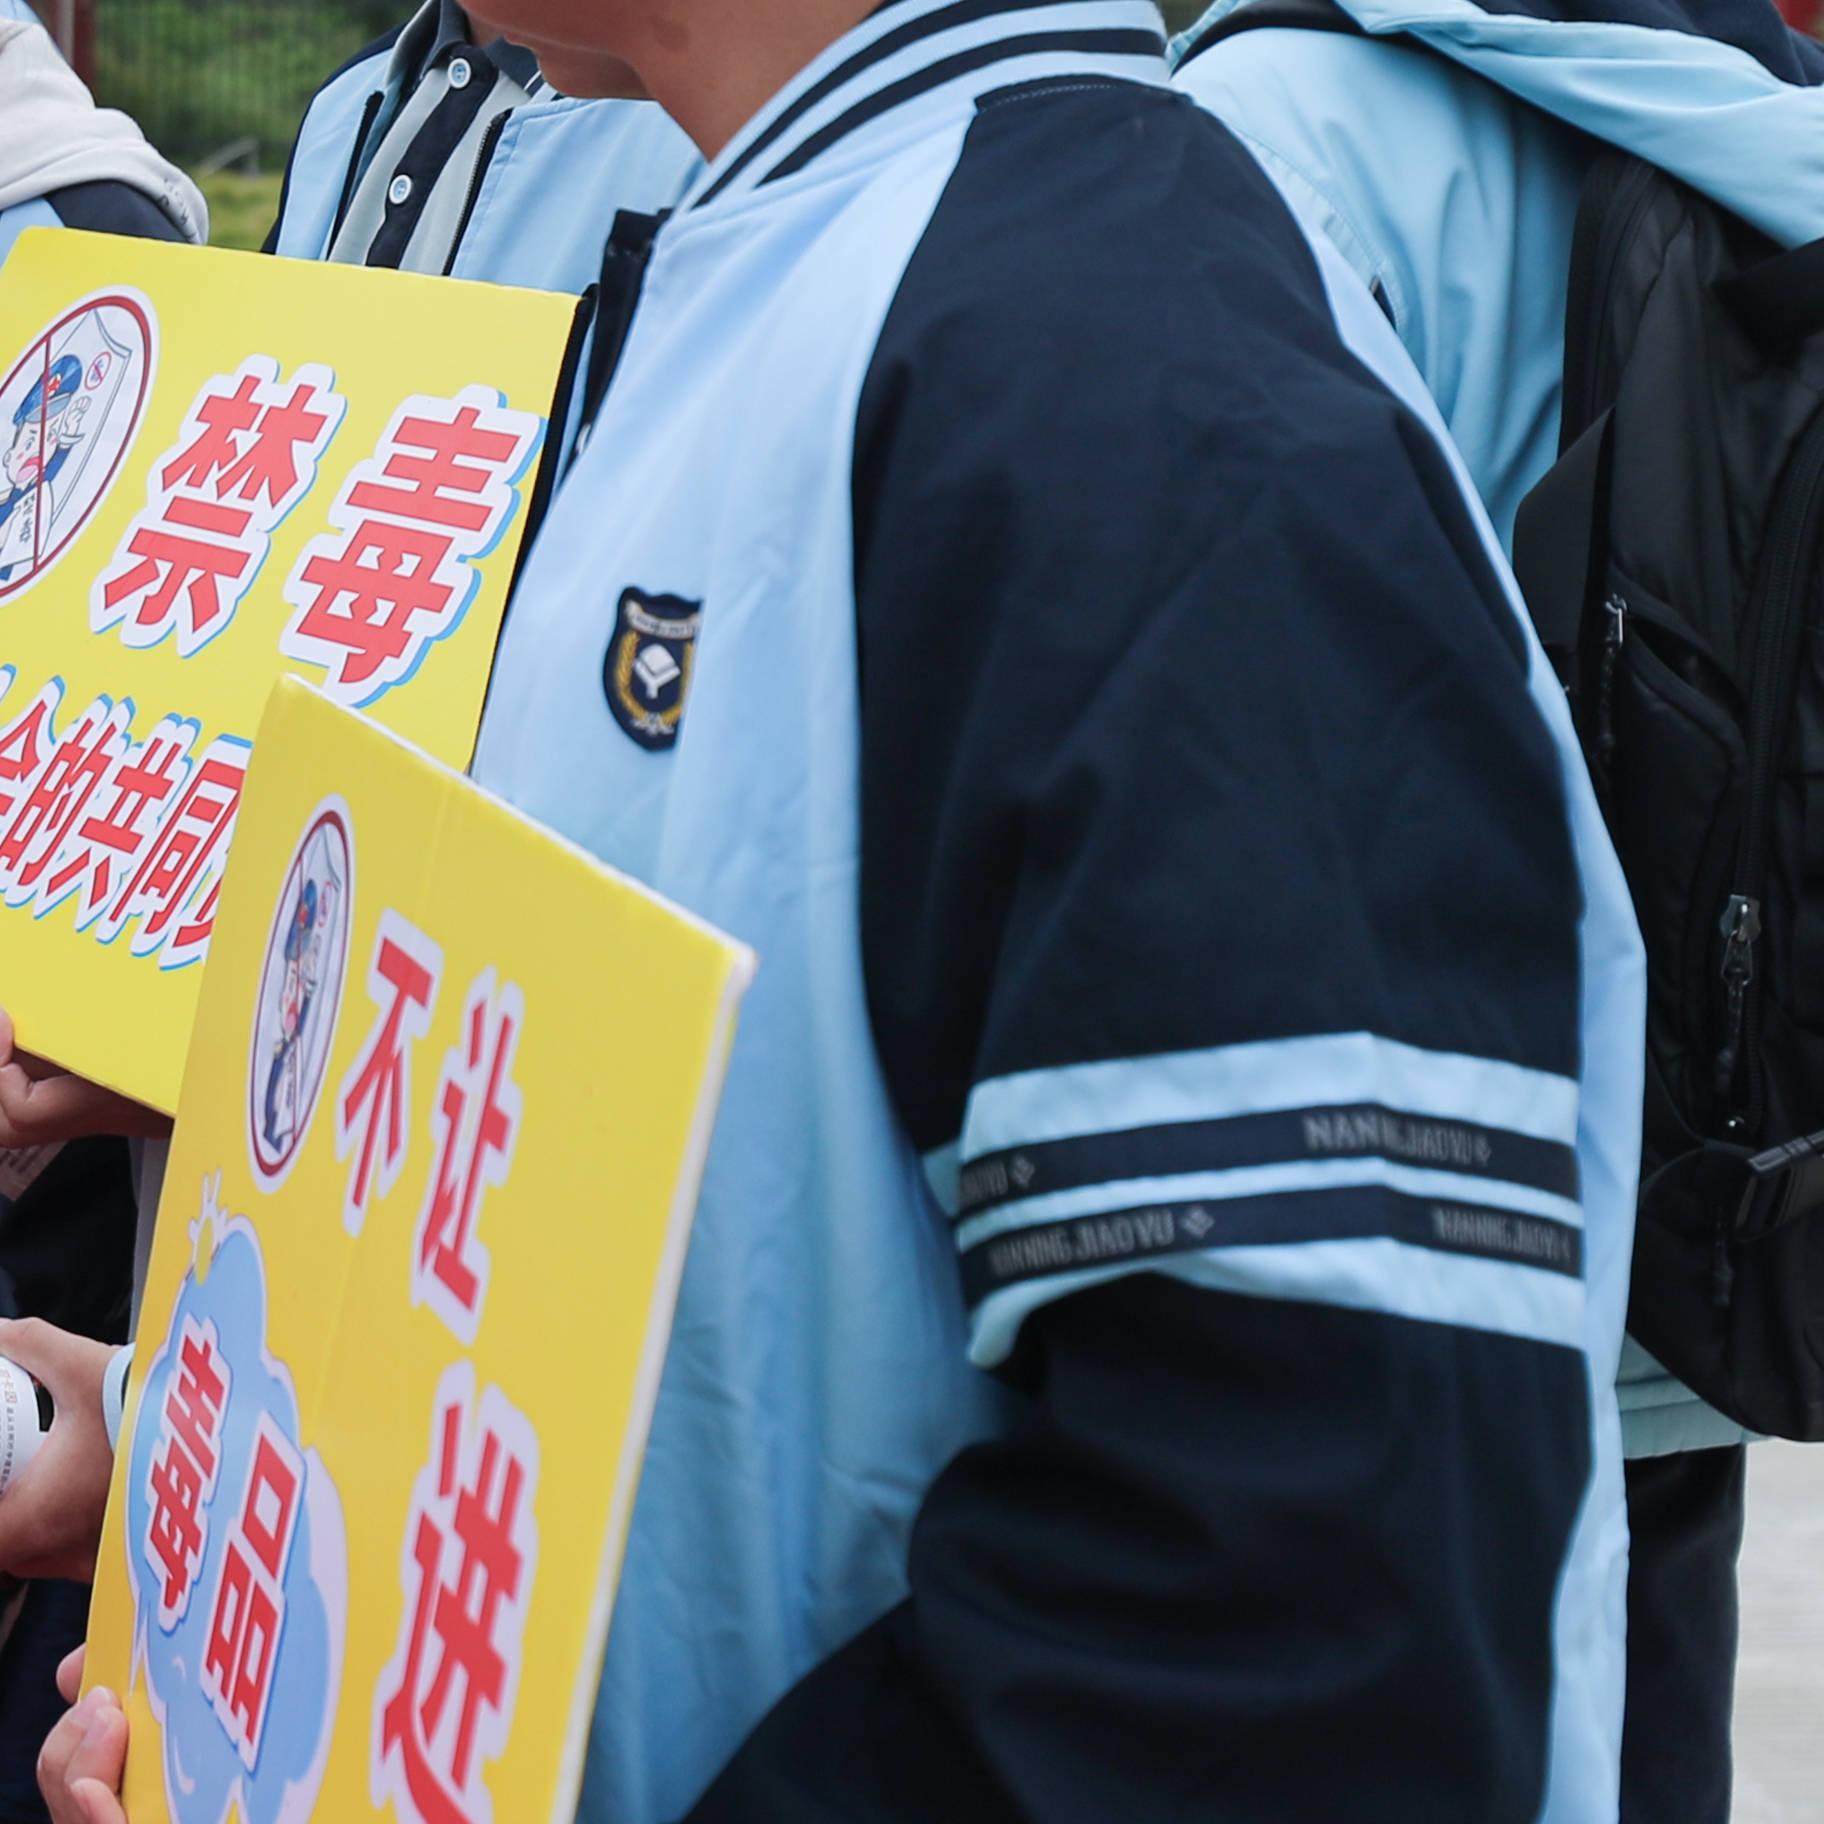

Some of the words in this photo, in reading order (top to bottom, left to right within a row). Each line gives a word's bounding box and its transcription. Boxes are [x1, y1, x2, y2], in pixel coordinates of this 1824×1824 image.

[104, 374, 520, 684] 禁毒
[344, 938, 512, 1309] 不让
[149, 1337, 296, 1743] 毒品
[381, 1404, 523, 1824] 进
